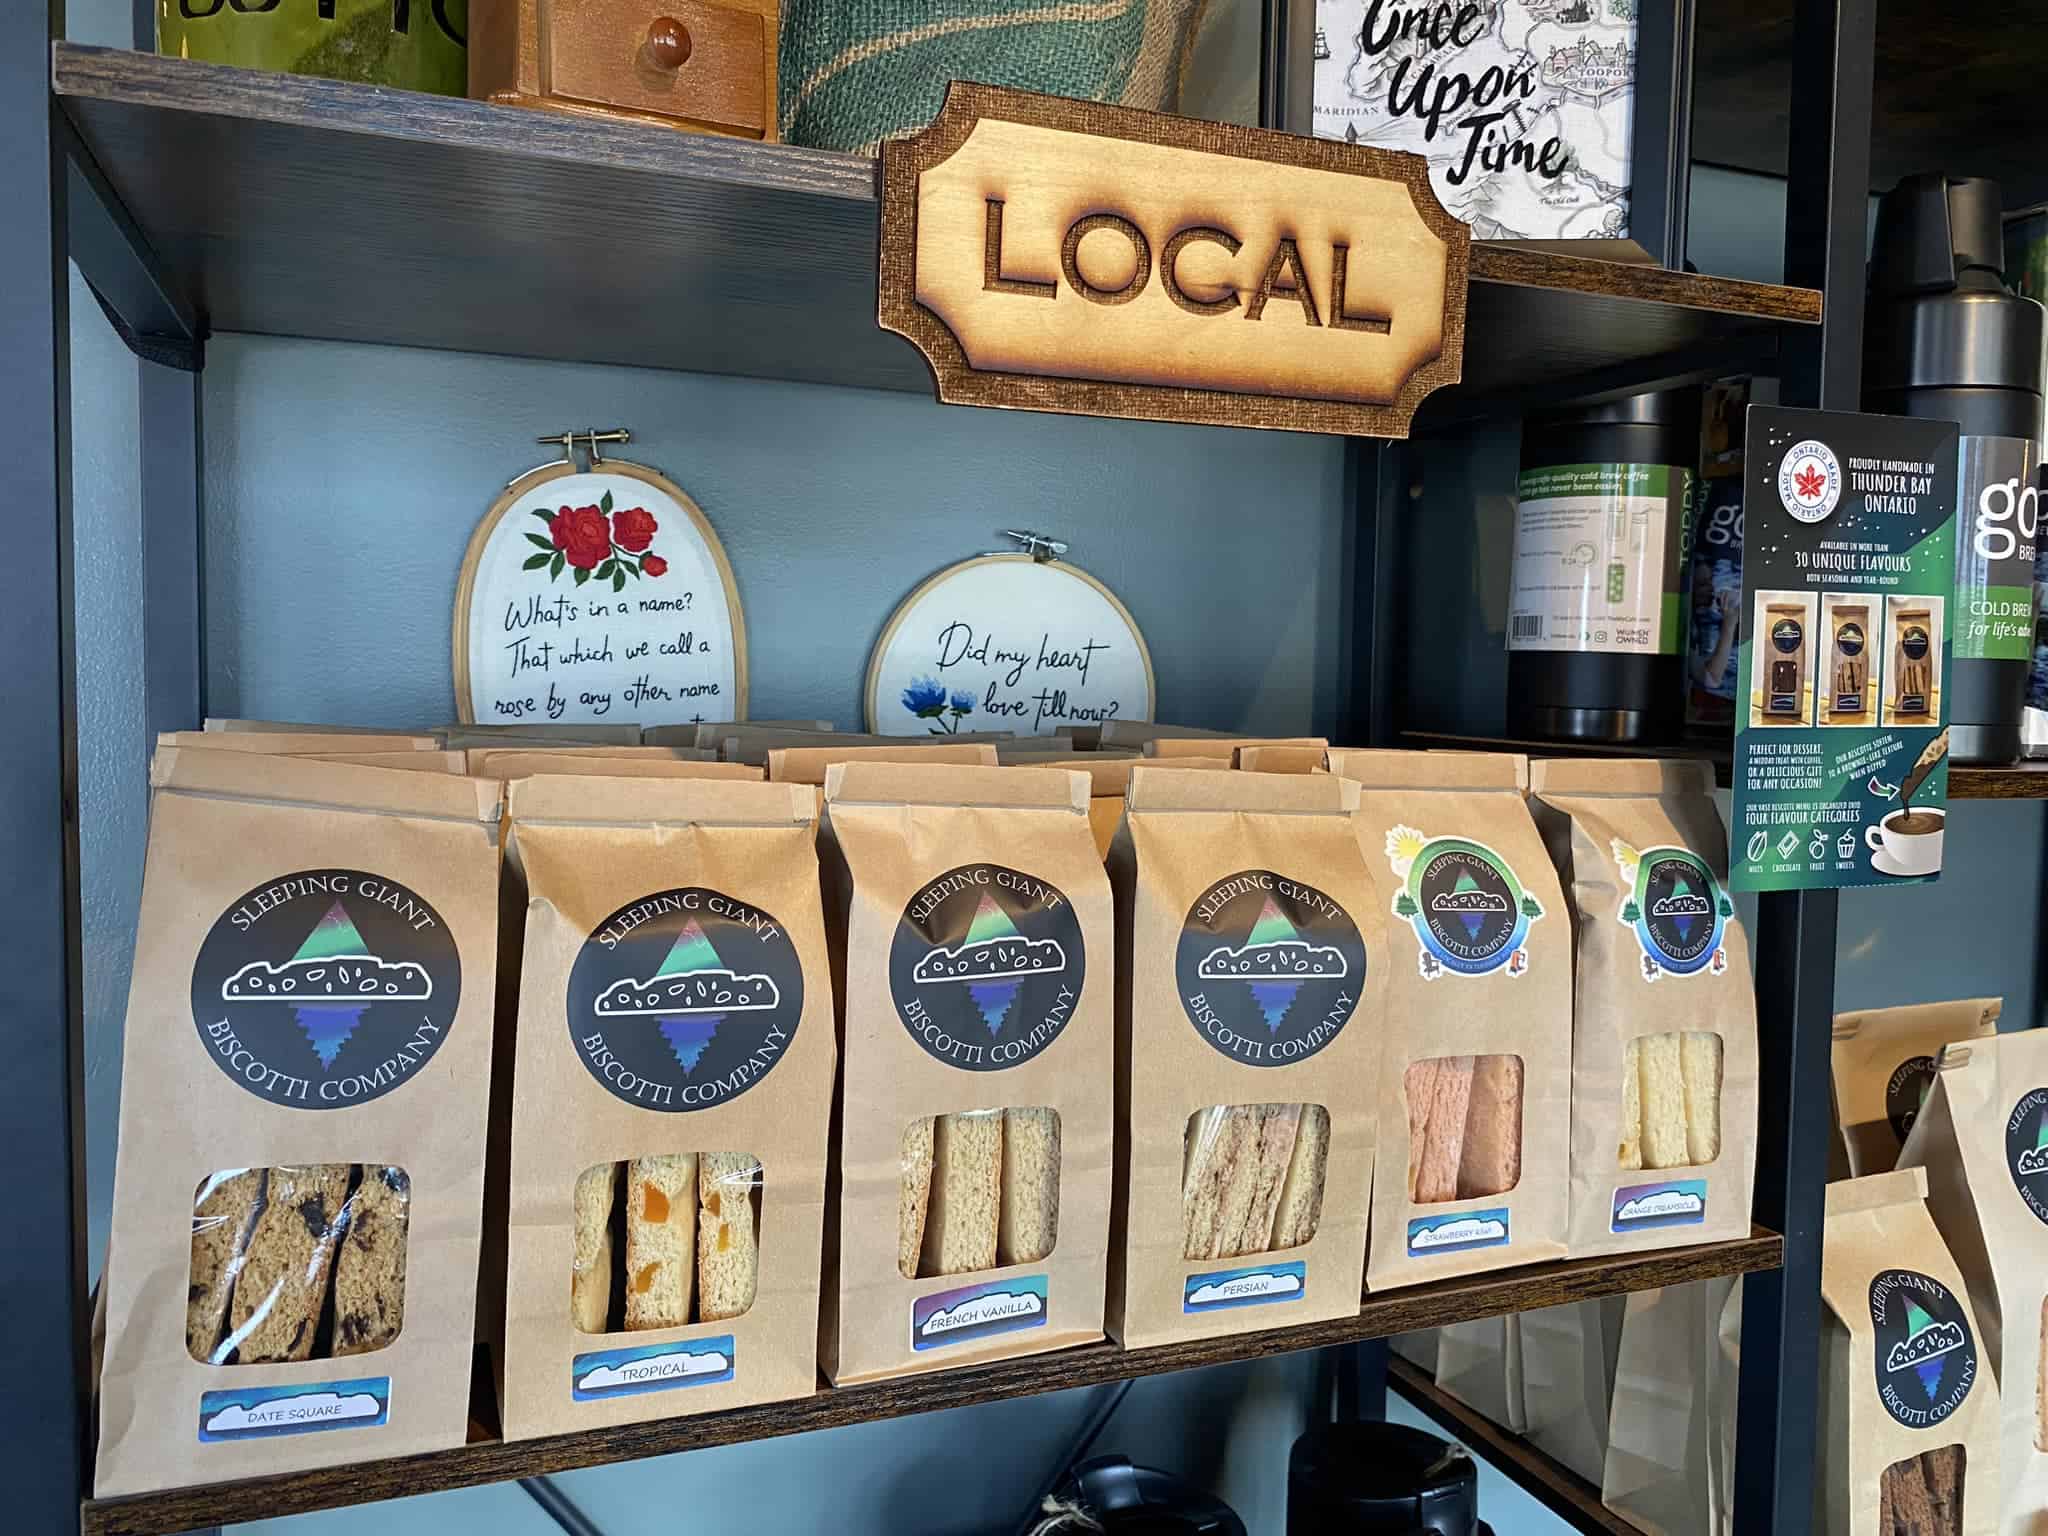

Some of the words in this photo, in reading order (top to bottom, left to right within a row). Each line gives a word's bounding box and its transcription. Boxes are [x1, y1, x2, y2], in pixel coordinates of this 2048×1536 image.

[1362, 0, 1485, 55] Once
[1388, 57, 1538, 142] Upon
[1447, 110, 1569, 186] Time
[982, 196, 1392, 334] LOCAL
[1849, 457, 1881, 471] PROUDLY
[1882, 459, 1923, 474] HANDMADE
[1925, 462, 1935, 474] IN
[1851, 472, 1907, 494] THUNDER
[1911, 476, 1932, 496] BAY
[1864, 494, 1917, 515] ONTARIO
[1974, 478, 2037, 560] go
[1794, 552, 1808, 567] 30
[1812, 552, 1856, 571] UNIQUE
[1861, 554, 1911, 572] FLAVOURS
[504, 594, 578, 631] What's
[588, 601, 610, 616] in
[617, 602, 628, 614] a
[639, 592, 693, 612] name?
[1967, 621, 1990, 640] for
[1993, 621, 2016, 640] life's
[1970, 601, 2010, 616] COLD
[505, 636, 553, 678] That
[559, 634, 613, 664] which
[625, 642, 648, 659] we
[659, 632, 693, 655] call
[699, 639, 711, 653] a
[936, 620, 991, 672] Did
[995, 651, 1031, 687] my
[1036, 634, 1111, 686] heart
[494, 697, 536, 717] rose
[547, 682, 566, 719] by
[579, 690, 611, 714] any
[624, 674, 672, 708] other
[679, 681, 720, 698] name
[982, 681, 1028, 716] love
[1032, 688, 1066, 731] till
[1069, 701, 1119, 721] now?
[1748, 767, 1757, 777] OR
[1767, 766, 1804, 777] DELICIOUS
[1807, 766, 1822, 776] GIFT
[1749, 744, 1776, 755] PERFECT
[1779, 744, 1791, 754] FOR
[1748, 778, 1760, 790] FOR
[1763, 778, 1777, 790] ANY
[1780, 778, 1822, 789] OCCASION!
[1746, 813, 1768, 825] FOUR
[1771, 811, 1808, 824] FLAVOUR
[1811, 810, 1860, 823] CATEGORIES
[1426, 854, 1465, 880] SLEEPING
[1467, 856, 1501, 882] GIANT
[231, 875, 349, 932] SLEEPING
[359, 880, 435, 931] GIANT
[911, 869, 989, 924] SLEEPING
[996, 872, 1063, 910] GIANT
[1196, 875, 1273, 923] SLEEPING
[1278, 881, 1342, 921] GIANT
[599, 894, 699, 950] SLEEPING
[708, 897, 780, 945] GIANT
[1430, 918, 1469, 956] BISCOTTI
[1471, 918, 1514, 957] COMPANY
[904, 998, 984, 1063] BISCOTTI
[990, 984, 1075, 1063] COMPANY
[1189, 992, 1263, 1059] BISCOTTI
[1269, 990, 1353, 1059] COMPANY
[207, 1017, 309, 1100] BISCOTTI
[319, 1016, 441, 1101] COMPANY
[583, 1032, 673, 1104] BISCOTTI
[681, 1024, 787, 1104] COMPANY
[1223, 1280, 1269, 1296] PERSIAN
[1873, 1275, 1899, 1326] SLEEPING
[1898, 1274, 1947, 1299] GIANT
[930, 1312, 978, 1331] FRENCH
[981, 1301, 1033, 1318] VANILLA
[622, 1362, 689, 1381] TROPICAL
[1882, 1384, 1927, 1424] BISCOTTI
[1930, 1355, 1975, 1421] COMPANY
[248, 1410, 284, 1423] DATE
[288, 1404, 342, 1420] SQUARE
